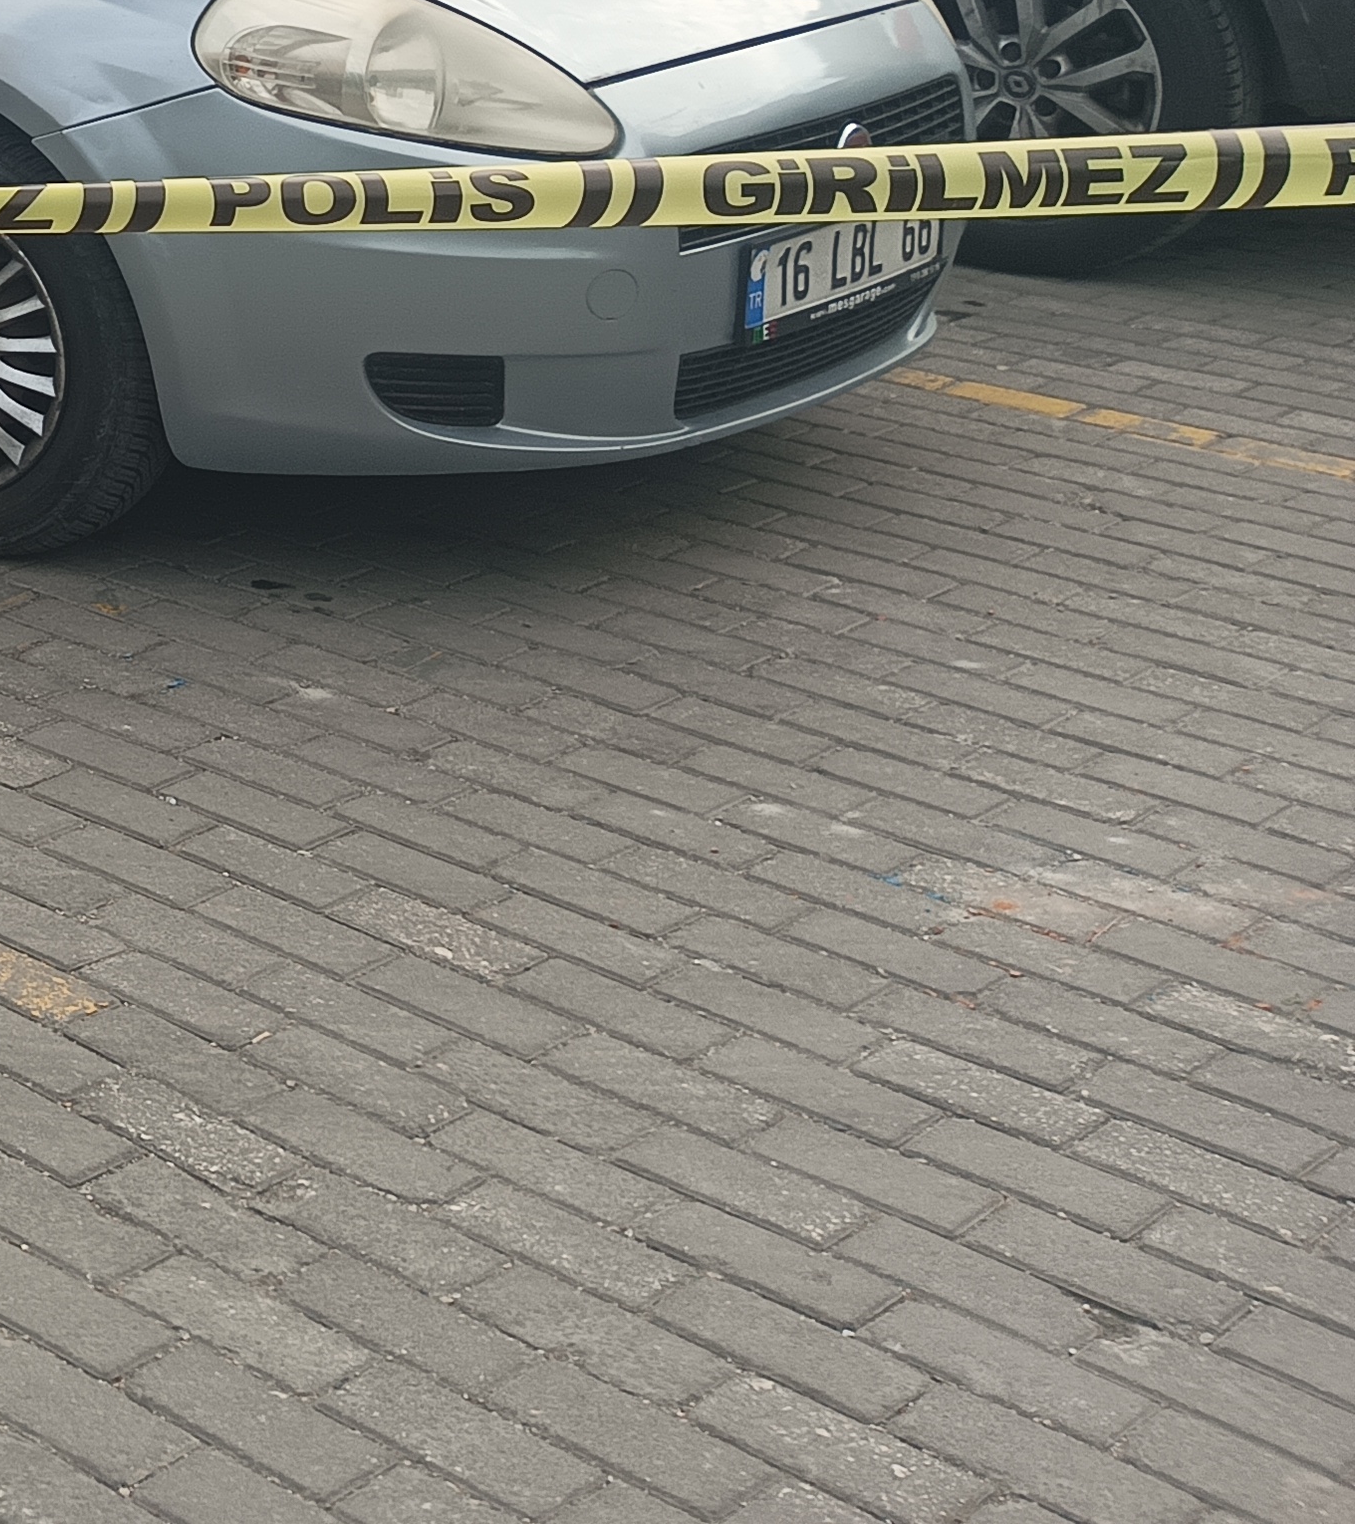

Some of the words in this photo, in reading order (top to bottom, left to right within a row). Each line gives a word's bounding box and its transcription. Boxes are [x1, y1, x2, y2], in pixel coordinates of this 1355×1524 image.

[209, 169, 536, 227] POLİS
[703, 143, 1190, 217] GİRİLMEZ
[749, 290, 763, 310] TR
[778, 240, 813, 307] 16
[831, 223, 883, 291] LBL
